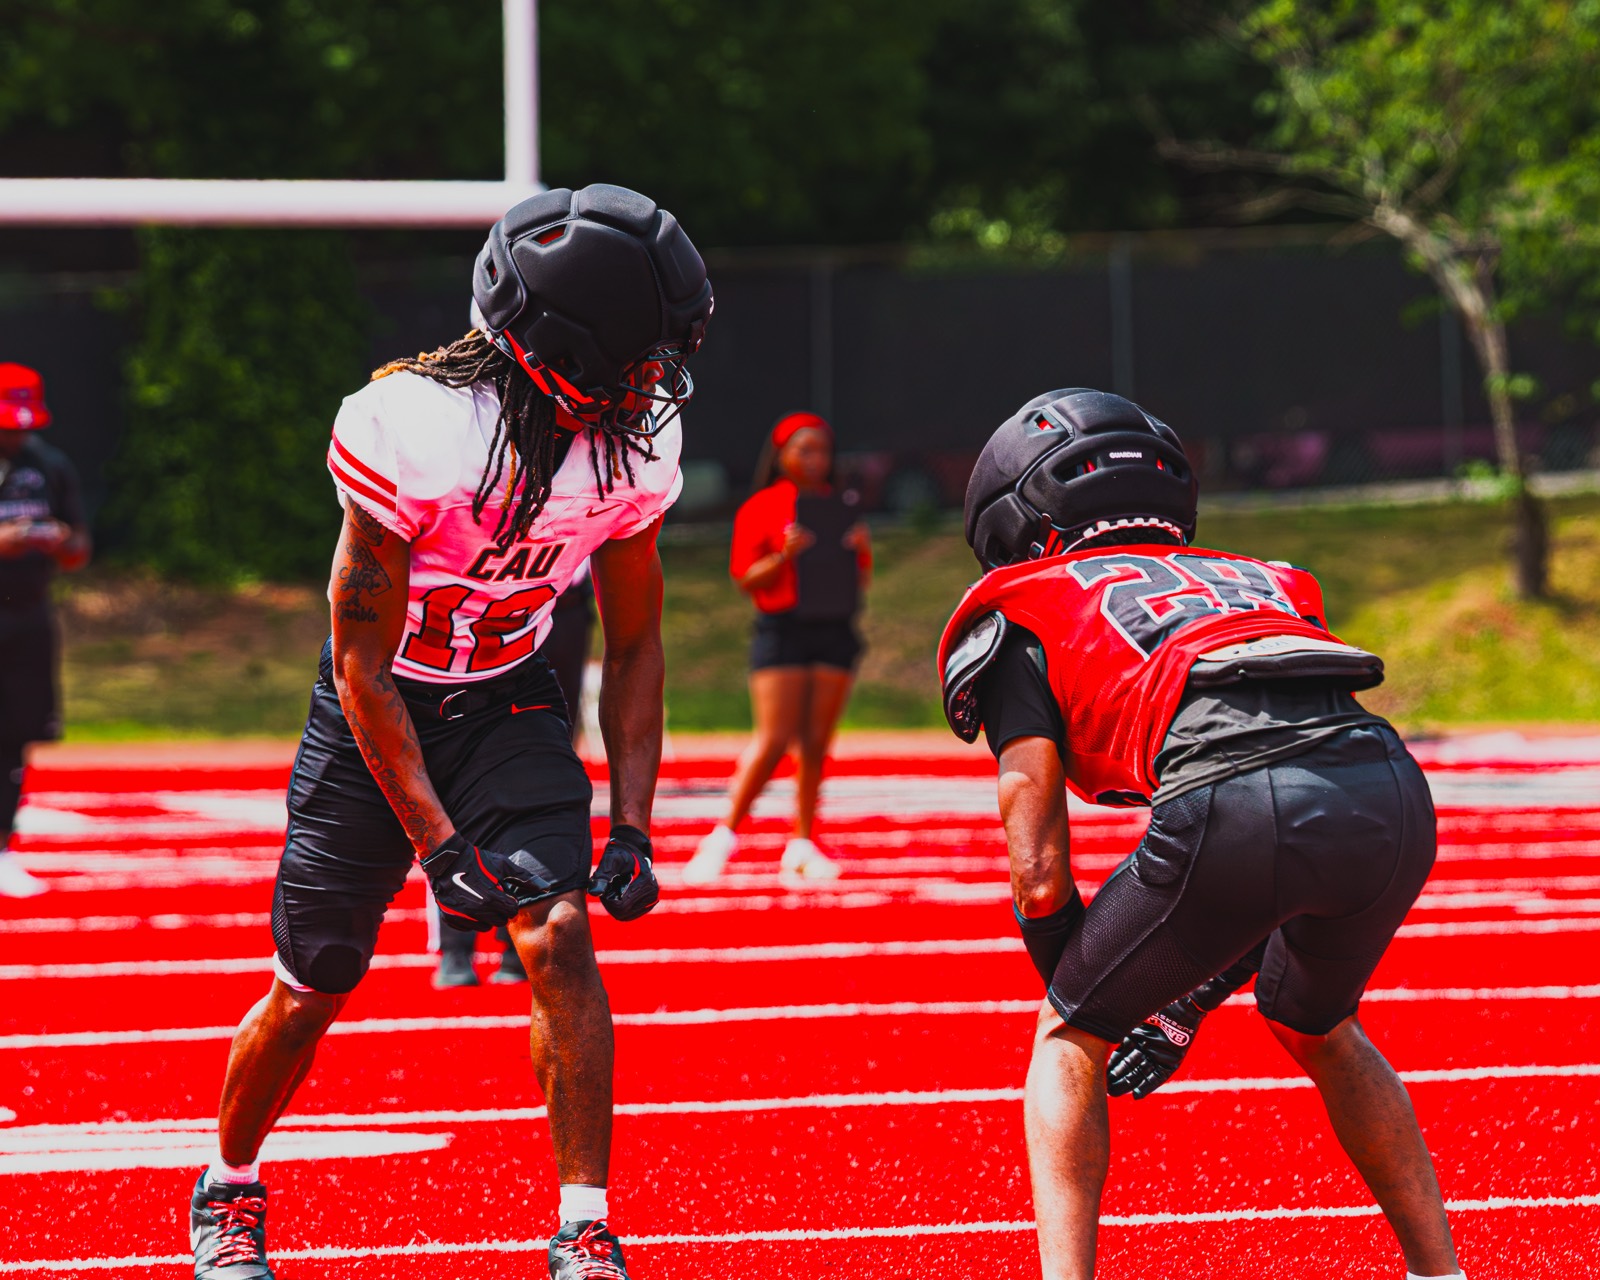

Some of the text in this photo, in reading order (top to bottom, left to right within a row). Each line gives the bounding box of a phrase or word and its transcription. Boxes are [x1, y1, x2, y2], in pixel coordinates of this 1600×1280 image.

[1108, 451, 1143, 459] GUARDIAN
[464, 541, 569, 583] CAU
[401, 583, 558, 674] 12
[1066, 553, 1301, 662] 28
